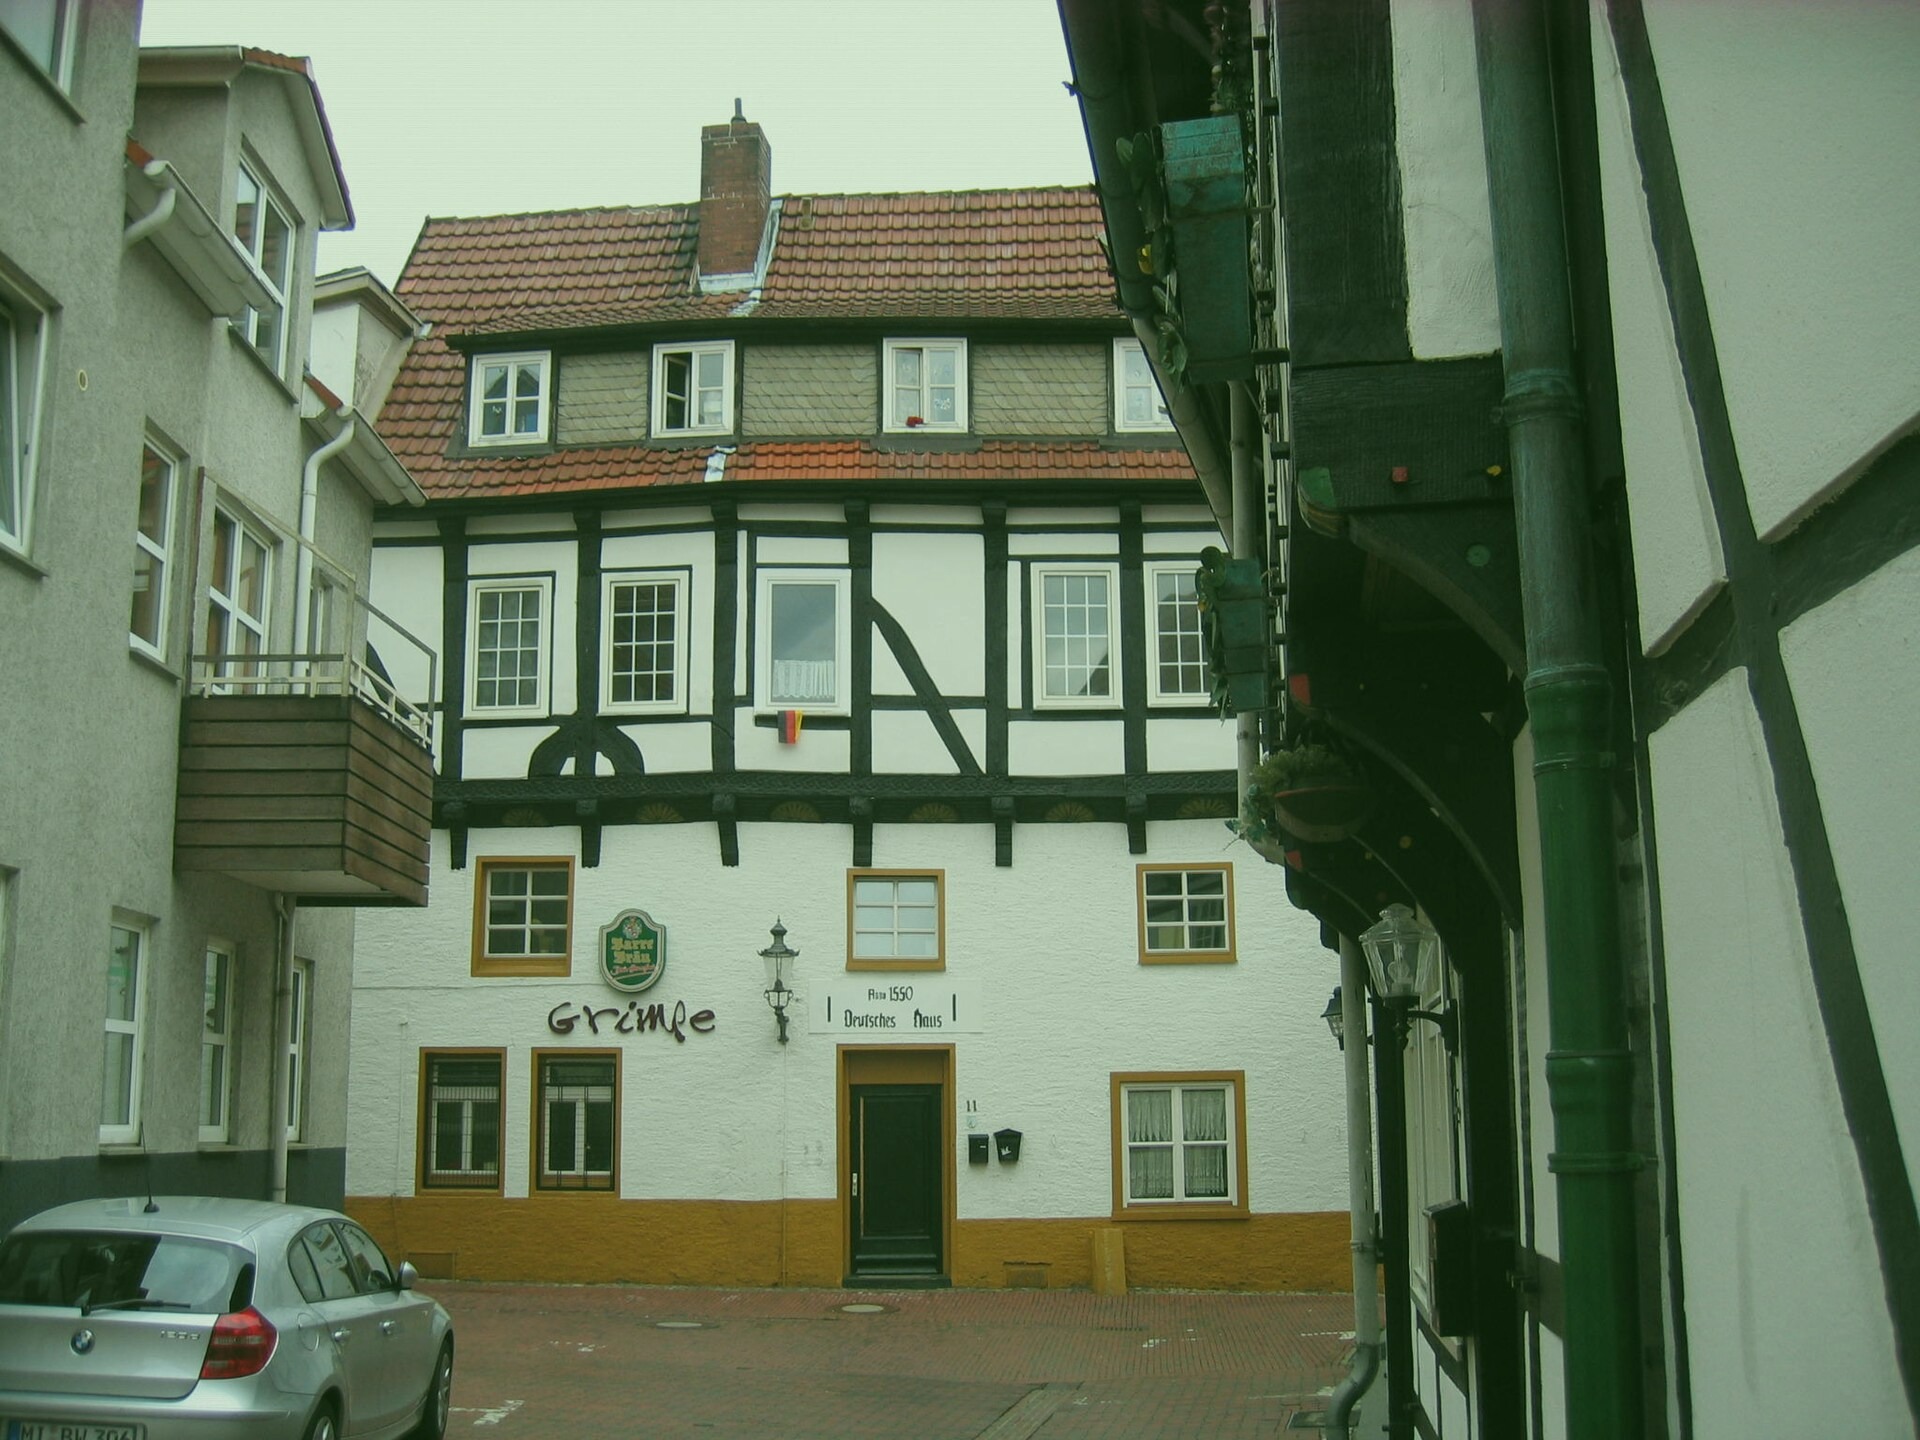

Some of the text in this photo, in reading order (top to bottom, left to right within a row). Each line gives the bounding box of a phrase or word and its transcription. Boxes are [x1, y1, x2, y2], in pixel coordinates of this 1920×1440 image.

[889, 986, 914, 1002] 1550
[844, 1008, 943, 1029] Deutsches Haus
[966, 1100, 977, 1112] 11
